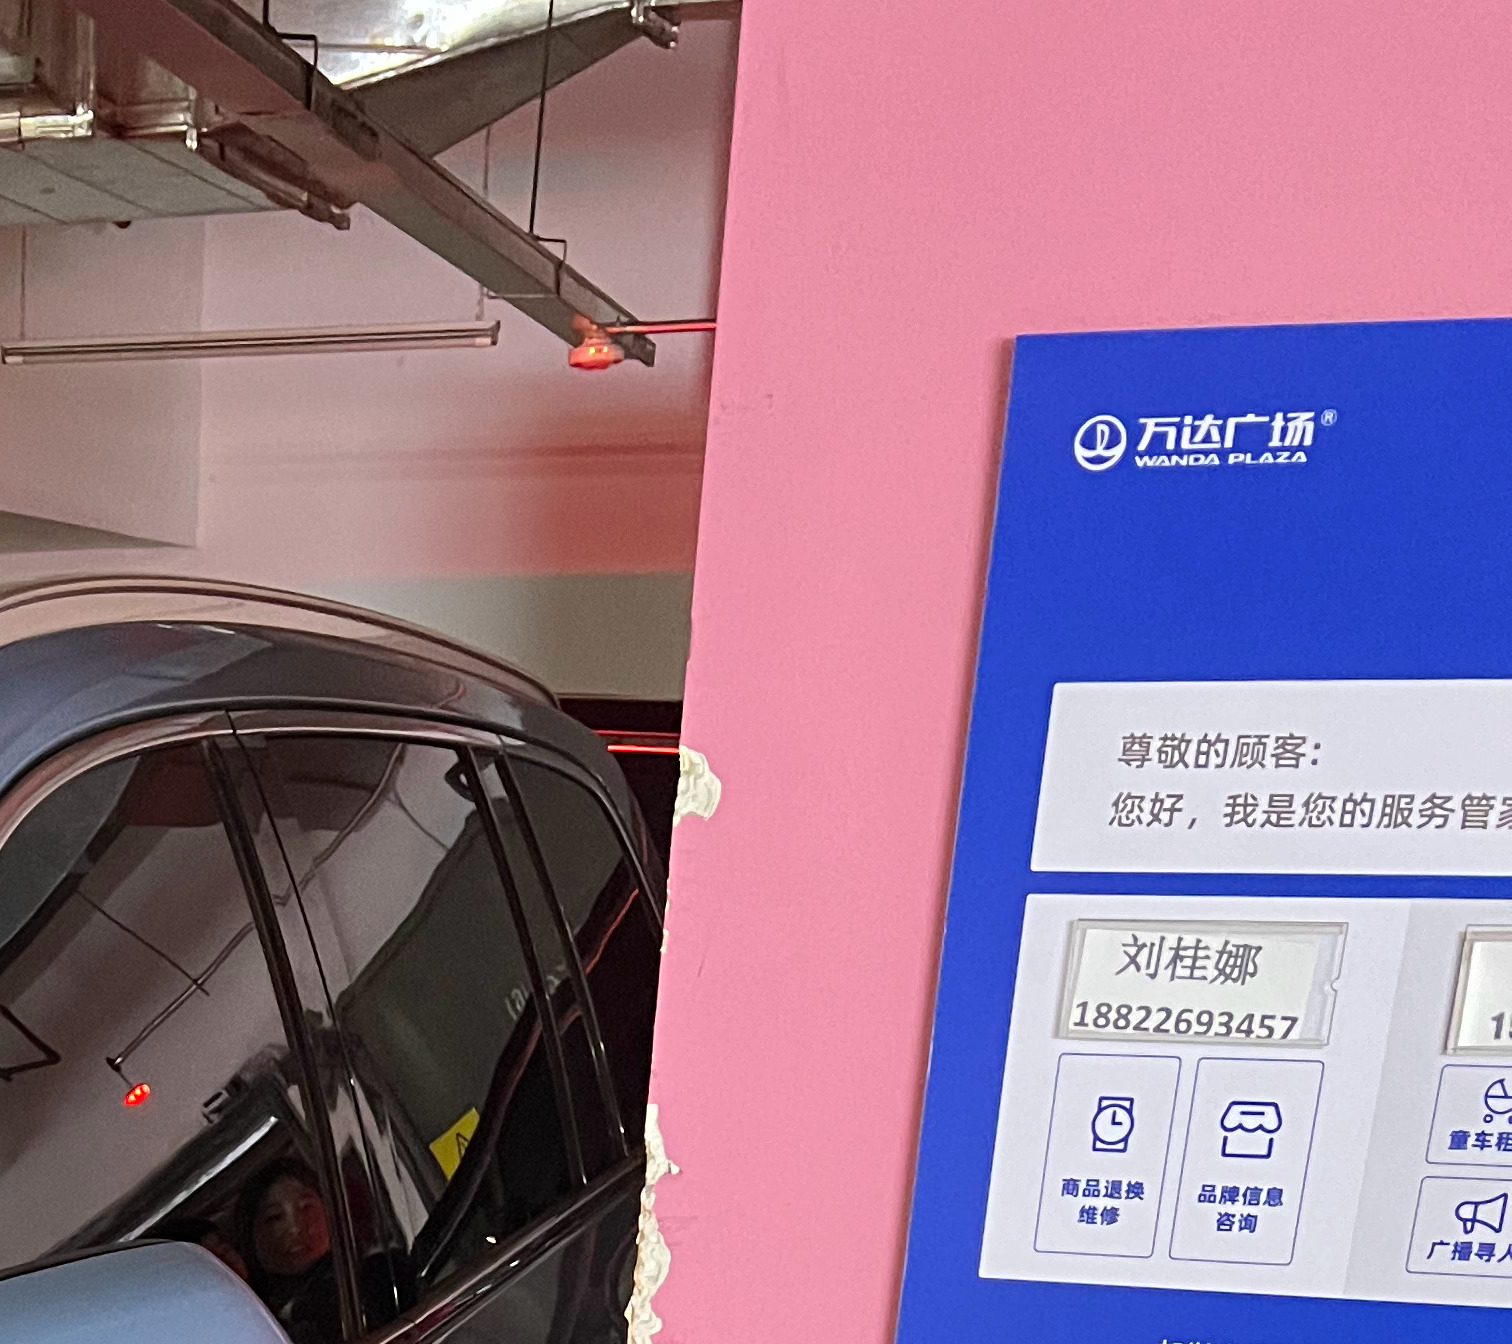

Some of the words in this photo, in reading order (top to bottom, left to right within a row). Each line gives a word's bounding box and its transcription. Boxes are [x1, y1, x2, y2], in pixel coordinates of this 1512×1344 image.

[1136, 411, 1316, 451] 万达广场
[1134, 453, 1220, 468] WANDA
[1227, 450, 1308, 466] PLAZA
[1115, 933, 1264, 986] 刘桂娜
[1073, 1000, 1299, 1041] 18822693457
[1061, 1177, 1145, 1201] 商品退换
[1197, 1183, 1285, 1207] 品牌信息
[1077, 1204, 1121, 1226] 维修
[1216, 1211, 1259, 1234] 咨询
